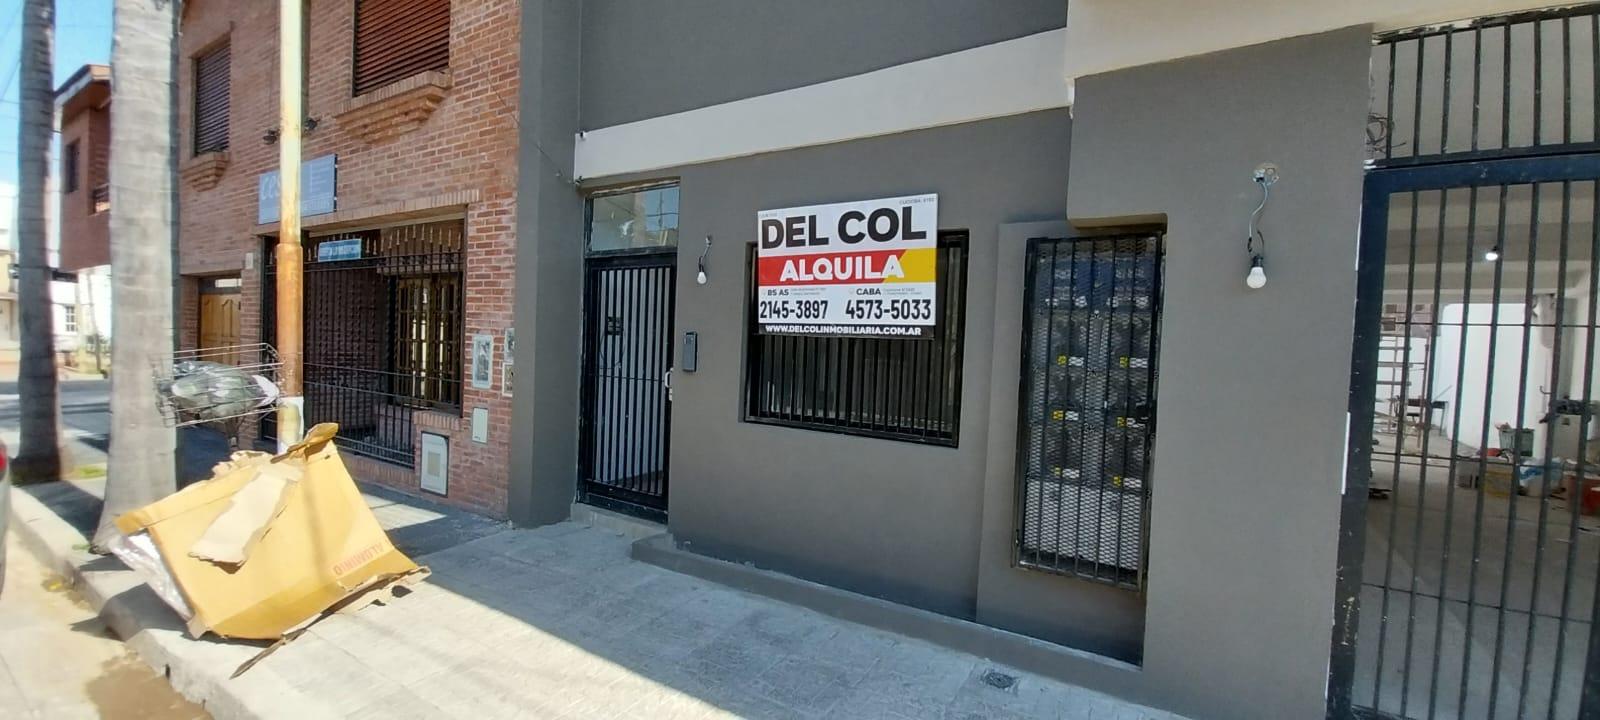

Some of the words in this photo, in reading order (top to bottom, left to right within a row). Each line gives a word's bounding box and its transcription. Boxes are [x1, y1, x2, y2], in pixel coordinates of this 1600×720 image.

[762, 215, 829, 249] DEL
[838, 206, 926, 244] COL
[780, 255, 904, 282] ALQUILA
[856, 287, 881, 296] CABA
[760, 300, 828, 319] 2145-3897
[845, 299, 931, 320] 4573-5033
[766, 324, 921, 336] WWW.DELCOLINMOBILIARIA.COM.AR
